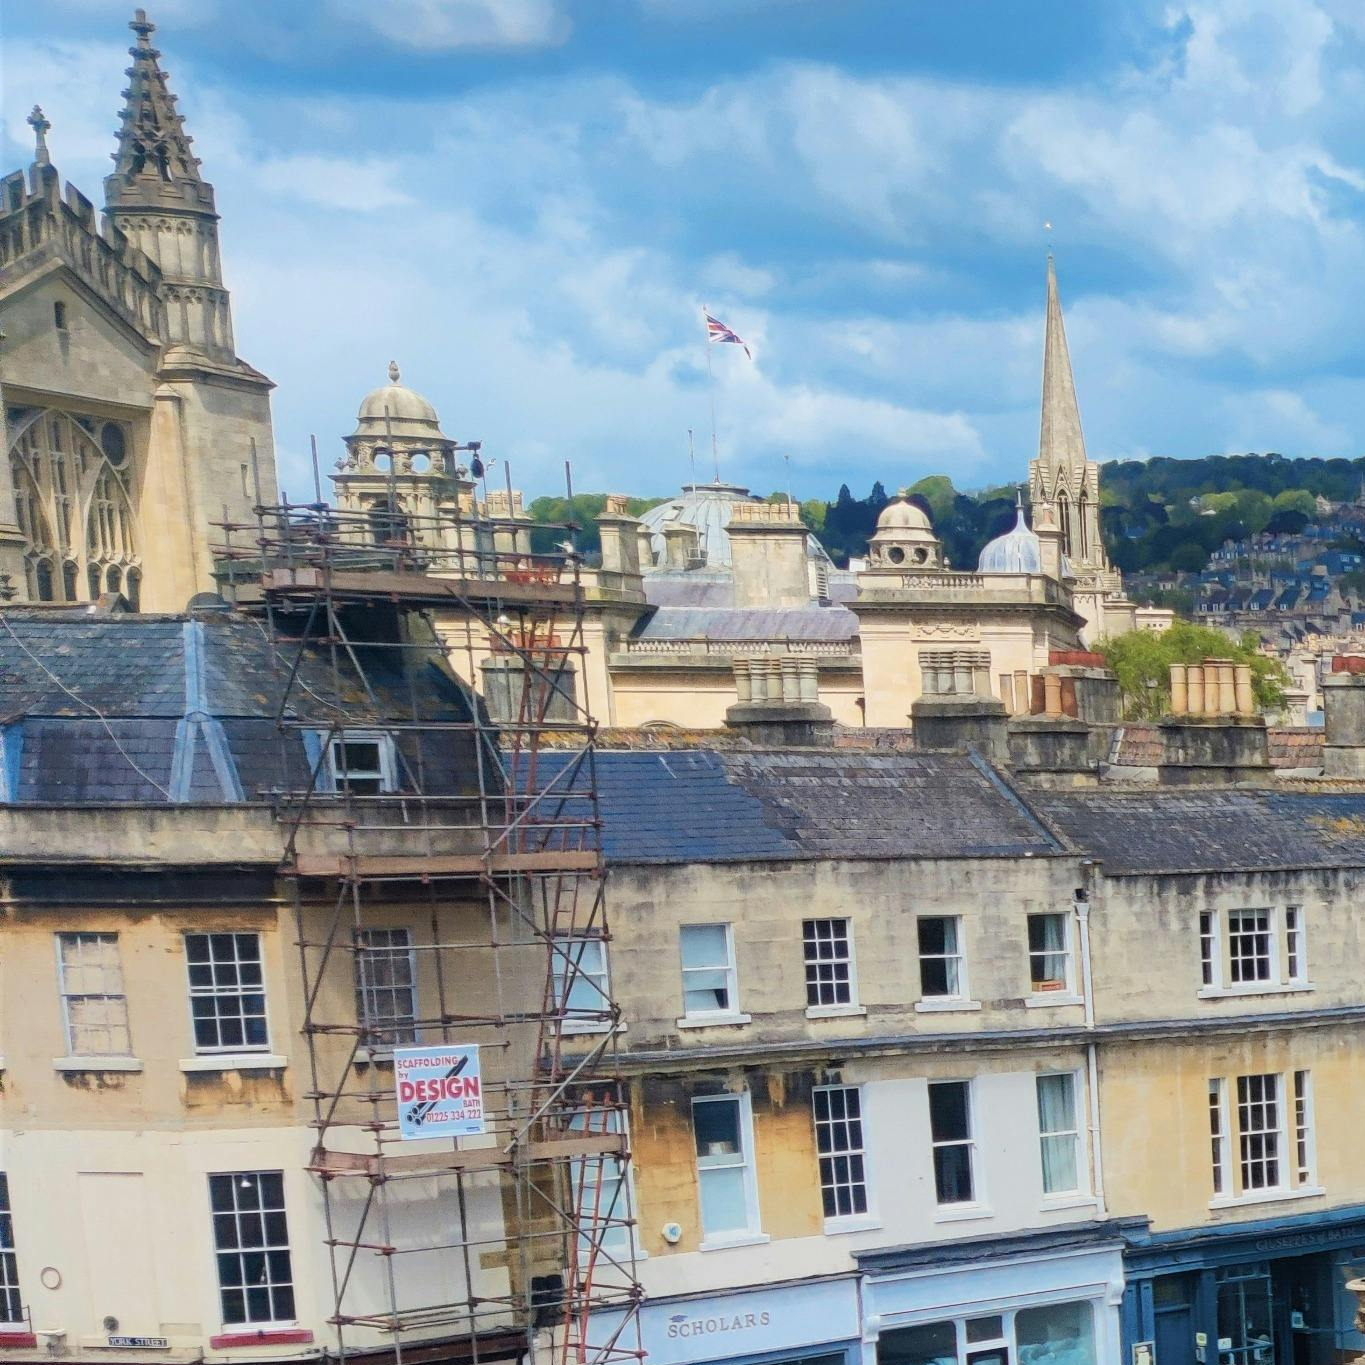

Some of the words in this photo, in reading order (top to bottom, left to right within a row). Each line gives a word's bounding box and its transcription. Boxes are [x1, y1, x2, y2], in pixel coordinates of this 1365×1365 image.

[398, 1056, 458, 1069] SCAFFOLDING
[398, 1071, 409, 1080] by
[400, 1077, 480, 1103] DESIGN
[463, 1099, 480, 1108] BATH
[426, 1111, 448, 1122] 01225
[451, 1110, 465, 1120] 334
[468, 1109, 481, 1119] 222
[668, 1312, 770, 1338] SCHOLARS
[110, 1337, 132, 1346] YORK
[135, 1338, 165, 1347] STREET
